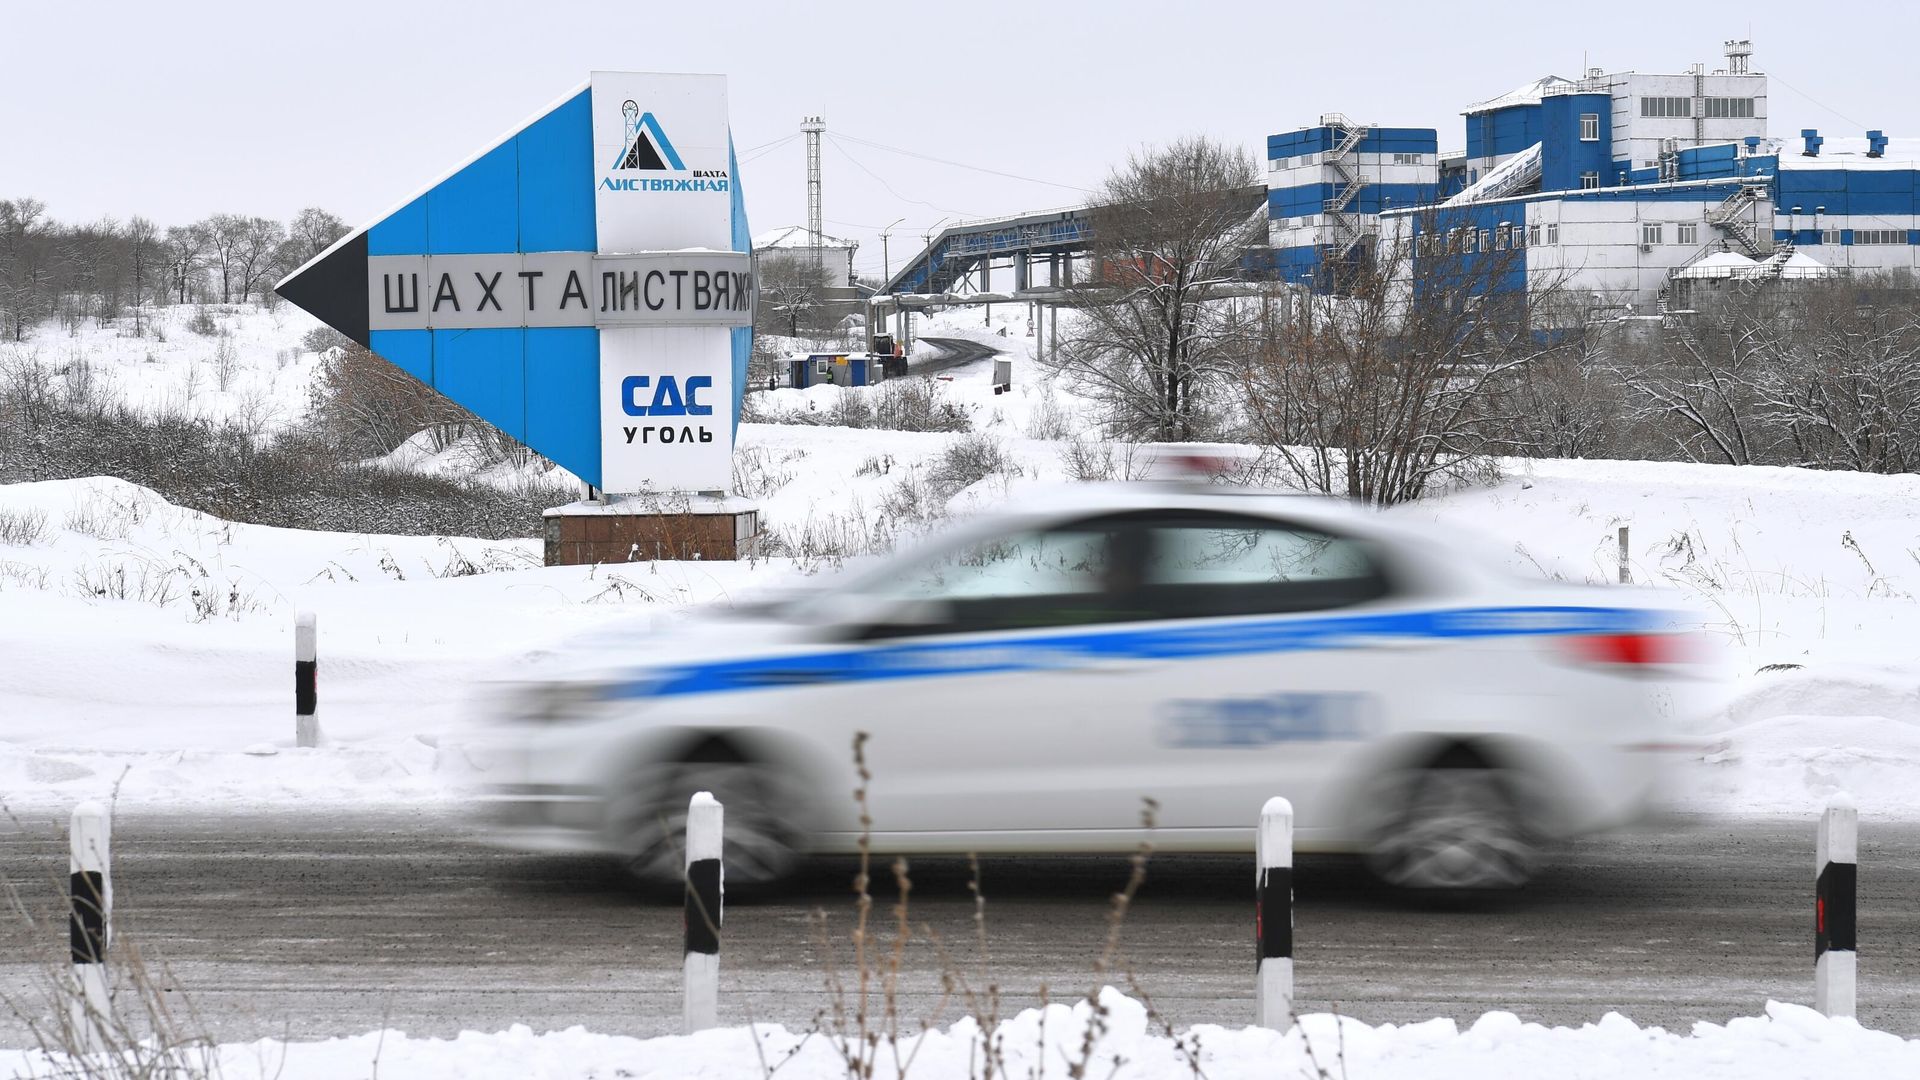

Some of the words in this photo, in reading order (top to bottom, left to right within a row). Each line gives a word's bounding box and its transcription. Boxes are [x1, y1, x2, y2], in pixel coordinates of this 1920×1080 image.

[693, 170, 728, 178] ШАХТА
[598, 176, 729, 192] ЛИСТВЯЖНАЯ
[384, 270, 588, 314] ШАХТА
[621, 375, 713, 416] СДС
[623, 426, 713, 444] УГОЛЬ
